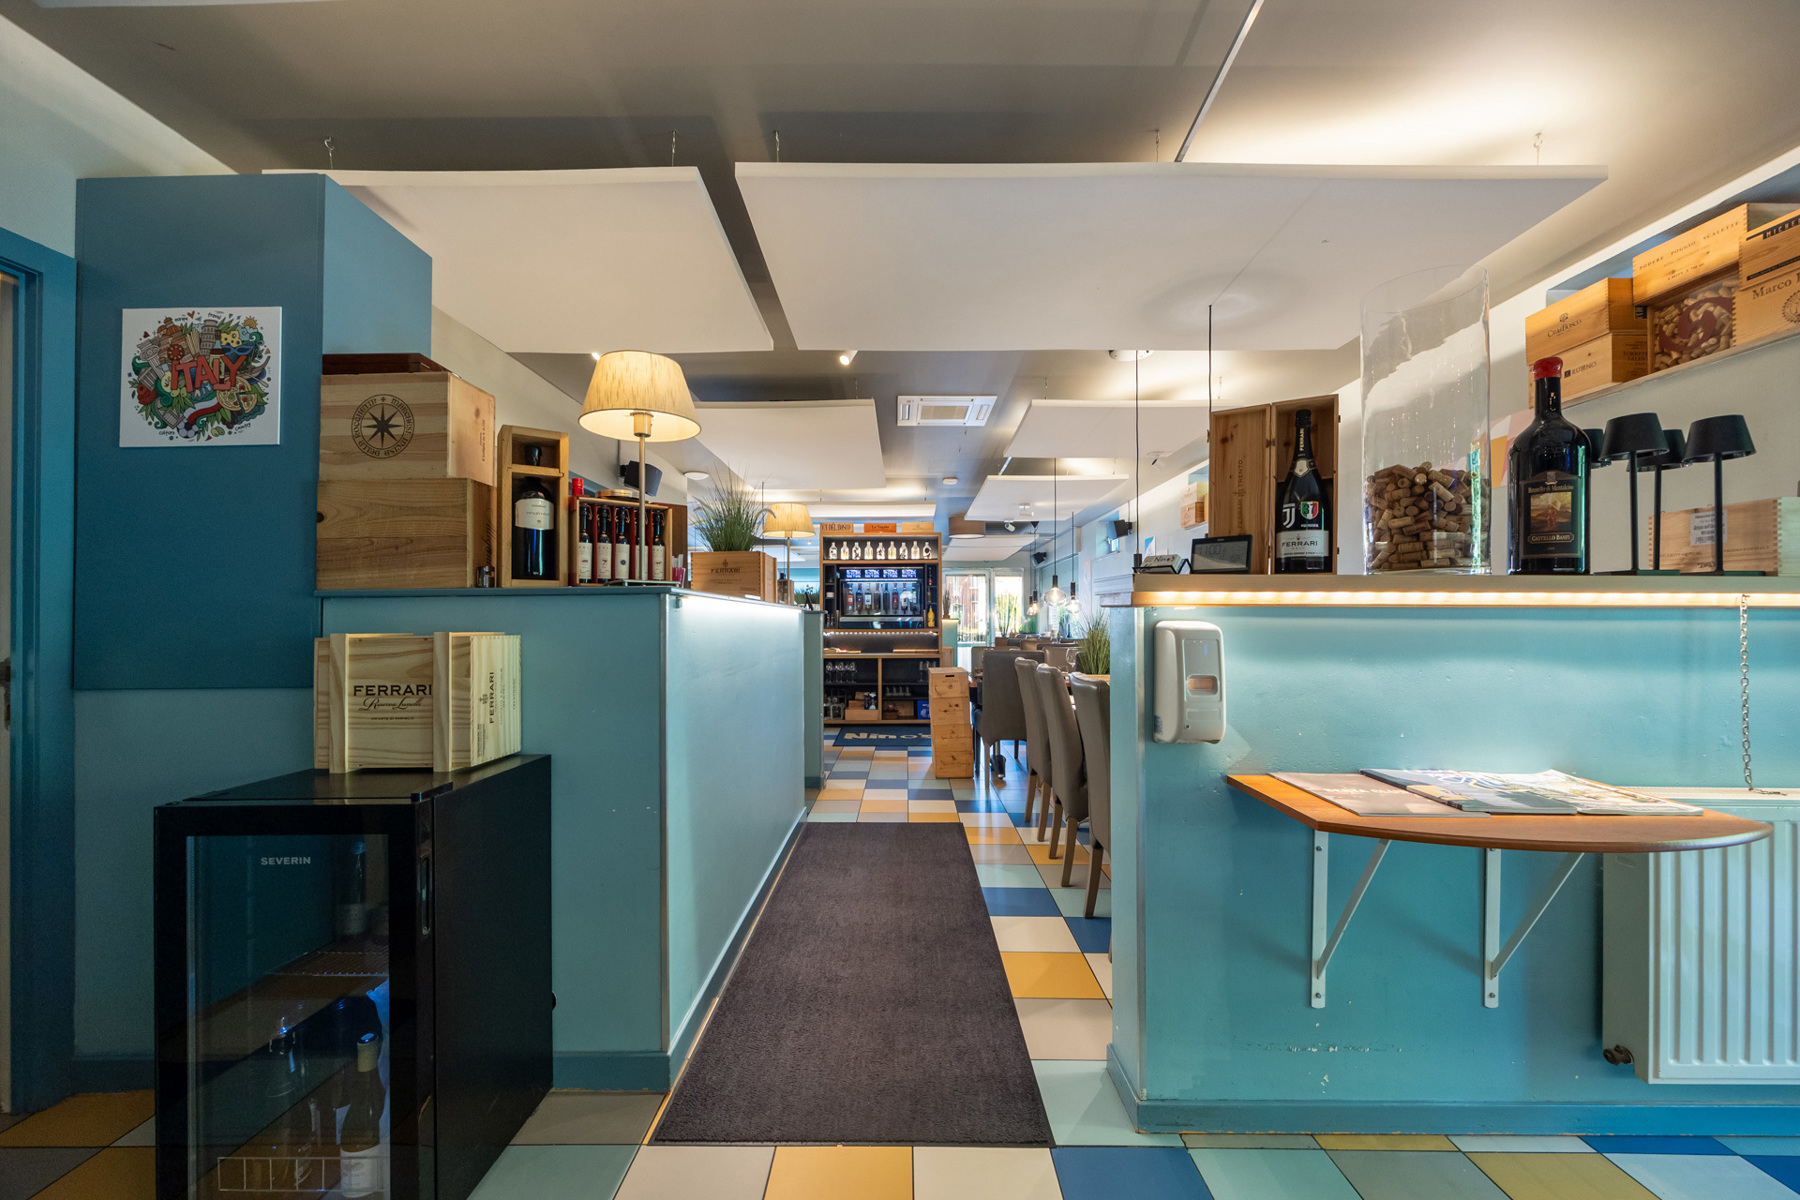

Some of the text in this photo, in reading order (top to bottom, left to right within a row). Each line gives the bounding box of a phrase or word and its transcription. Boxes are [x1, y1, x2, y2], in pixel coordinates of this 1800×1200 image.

[1638, 255, 1664, 271] PODERE
[1670, 240, 1696, 256] POGGIO
[1702, 220, 1740, 241] SCALETTE
[1752, 280, 1792, 300] Marco
[170, 355, 248, 392] ITALY
[1304, 504, 1316, 514] 37
[1282, 540, 1318, 548] FERRARI
[353, 684, 432, 696] FERRARI
[260, 856, 312, 866] SEVERIN
